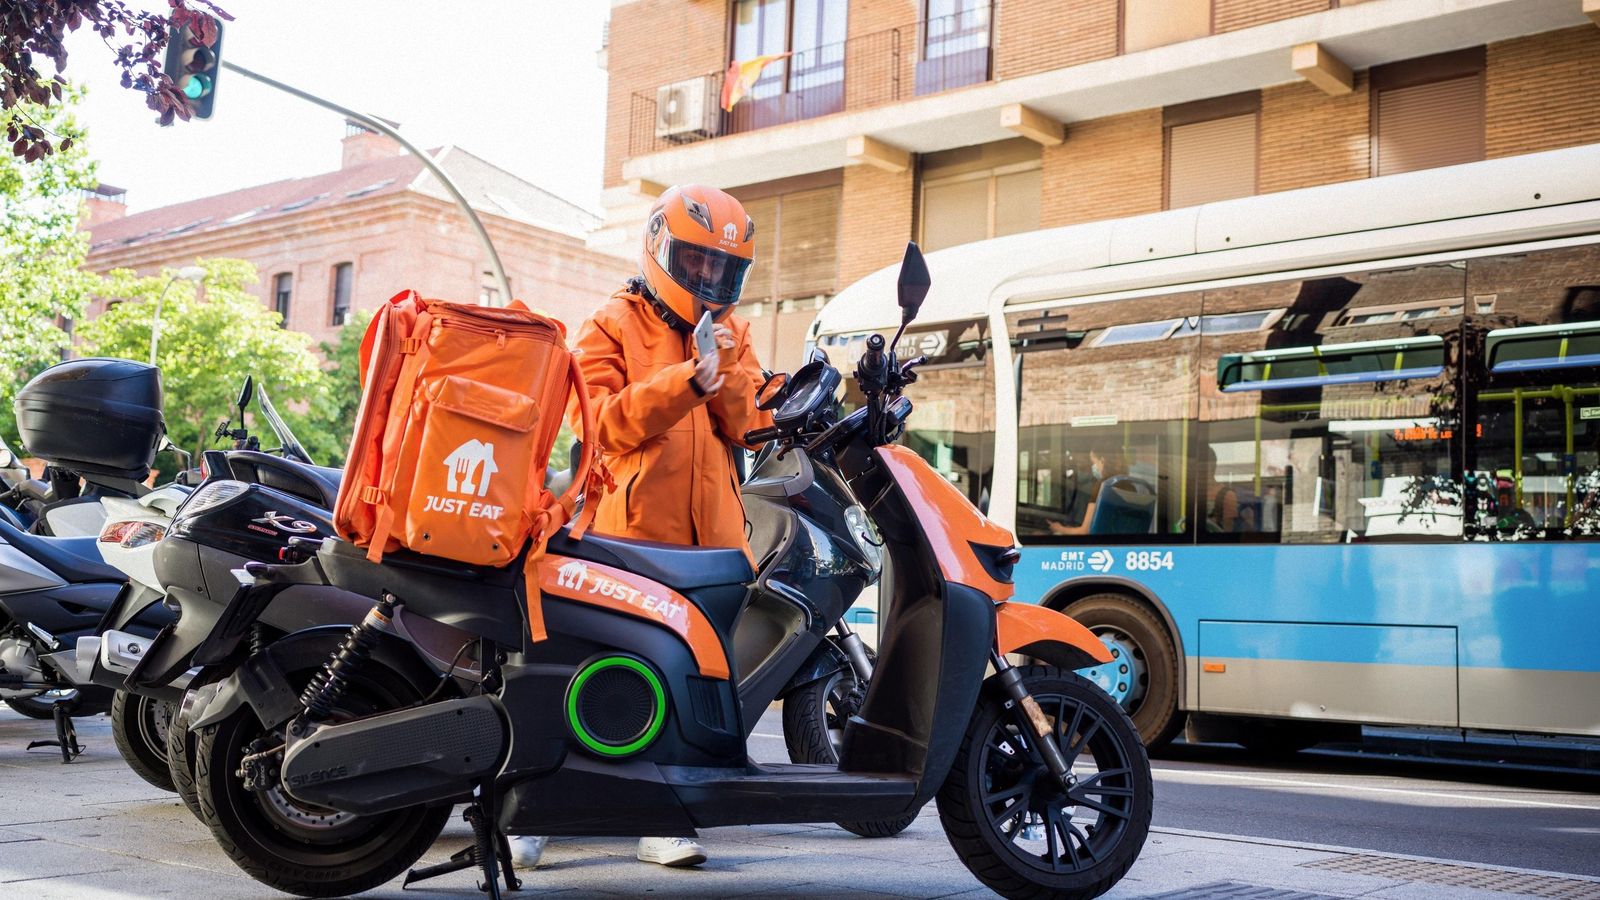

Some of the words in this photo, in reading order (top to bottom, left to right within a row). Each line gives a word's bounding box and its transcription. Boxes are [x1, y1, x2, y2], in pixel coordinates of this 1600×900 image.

[423, 495, 467, 515] JUST
[468, 502, 504, 520] EAT
[1041, 561, 1085, 571] MADRID
[1061, 551, 1085, 561] EMT
[1126, 551, 1174, 571] 8854
[588, 577, 642, 604] JUST
[641, 594, 681, 619] EAT
